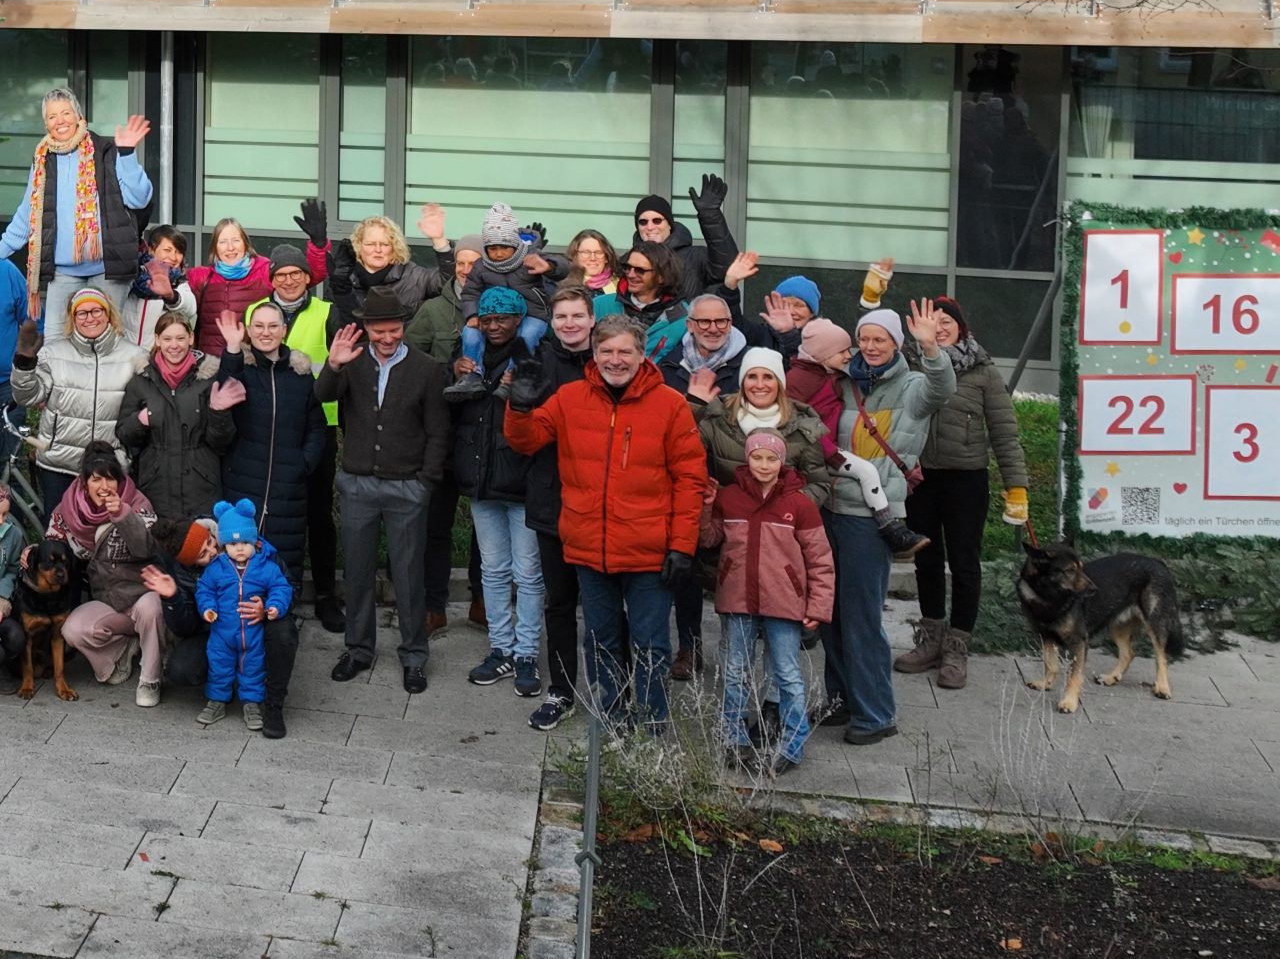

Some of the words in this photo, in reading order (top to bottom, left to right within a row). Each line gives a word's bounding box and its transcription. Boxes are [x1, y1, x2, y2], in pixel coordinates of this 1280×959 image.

[1110, 269, 1130, 309] 1
[1202, 294, 1260, 335] 16
[1106, 395, 1165, 435] 22
[1232, 422, 1260, 463] 3
[1164, 516, 1196, 527] täglich
[1198, 517, 1213, 526] ein
[1215, 516, 1255, 526] Türchen
